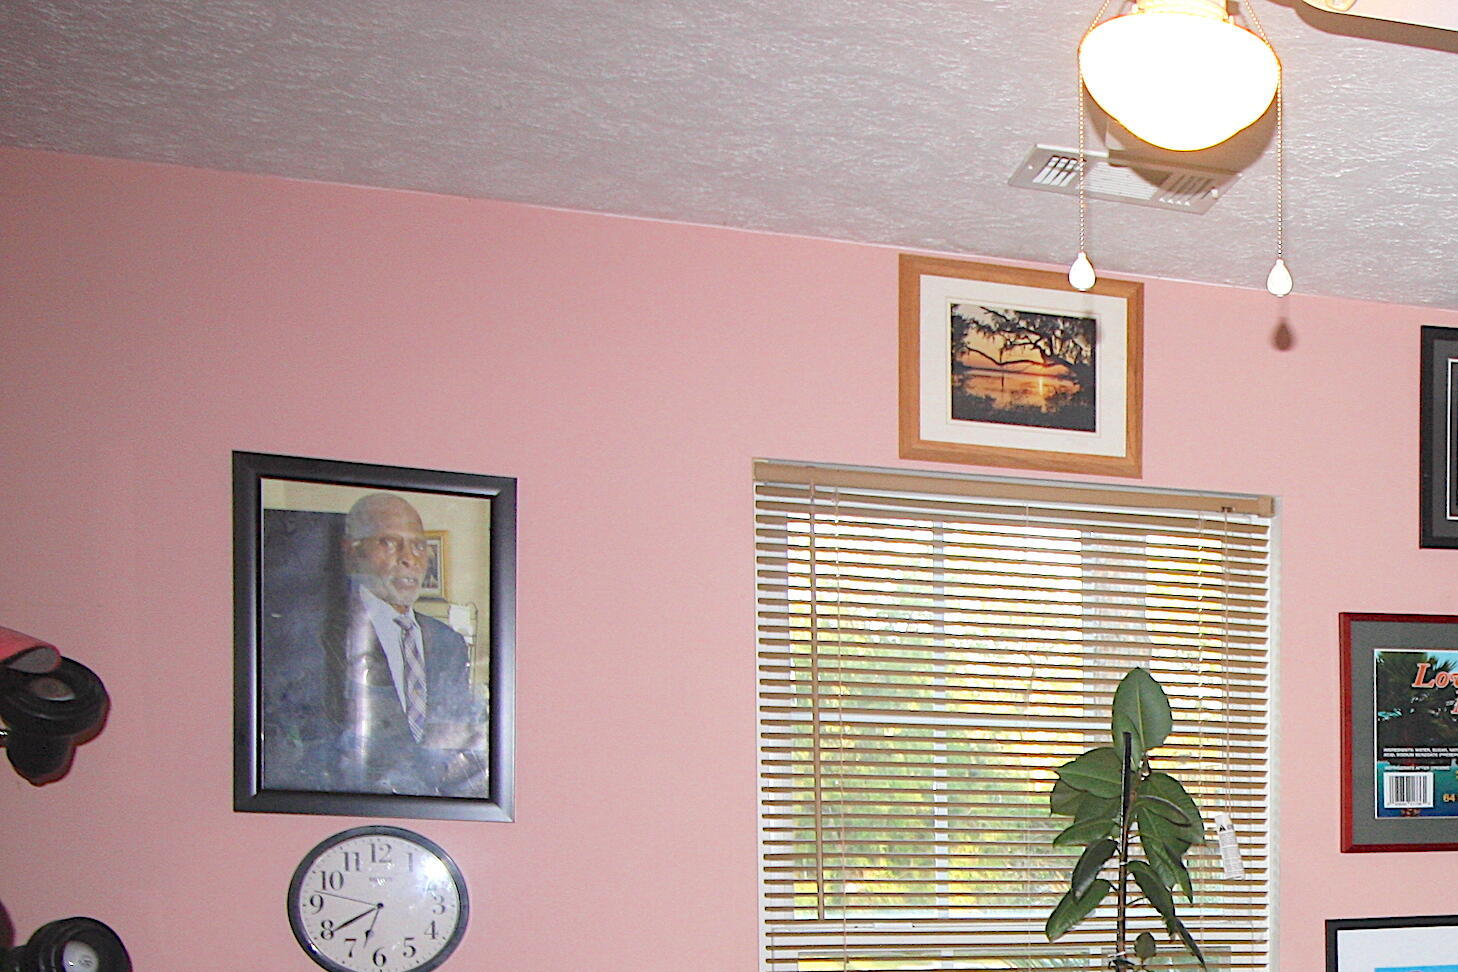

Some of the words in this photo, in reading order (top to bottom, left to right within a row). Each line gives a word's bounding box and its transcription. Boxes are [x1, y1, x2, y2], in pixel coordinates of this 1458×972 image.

[1442, 793, 1456, 802] 64
[344, 851, 360, 872] 11
[368, 842, 393, 864] 12
[406, 852, 414, 872] 1
[320, 870, 345, 891] 10
[309, 894, 324, 914] 9
[432, 895, 446, 915] 3
[320, 919, 335, 941] 8
[424, 920, 439, 940] 4
[344, 938, 358, 958] 7
[372, 947, 387, 968] 6
[402, 937, 417, 958] 5
